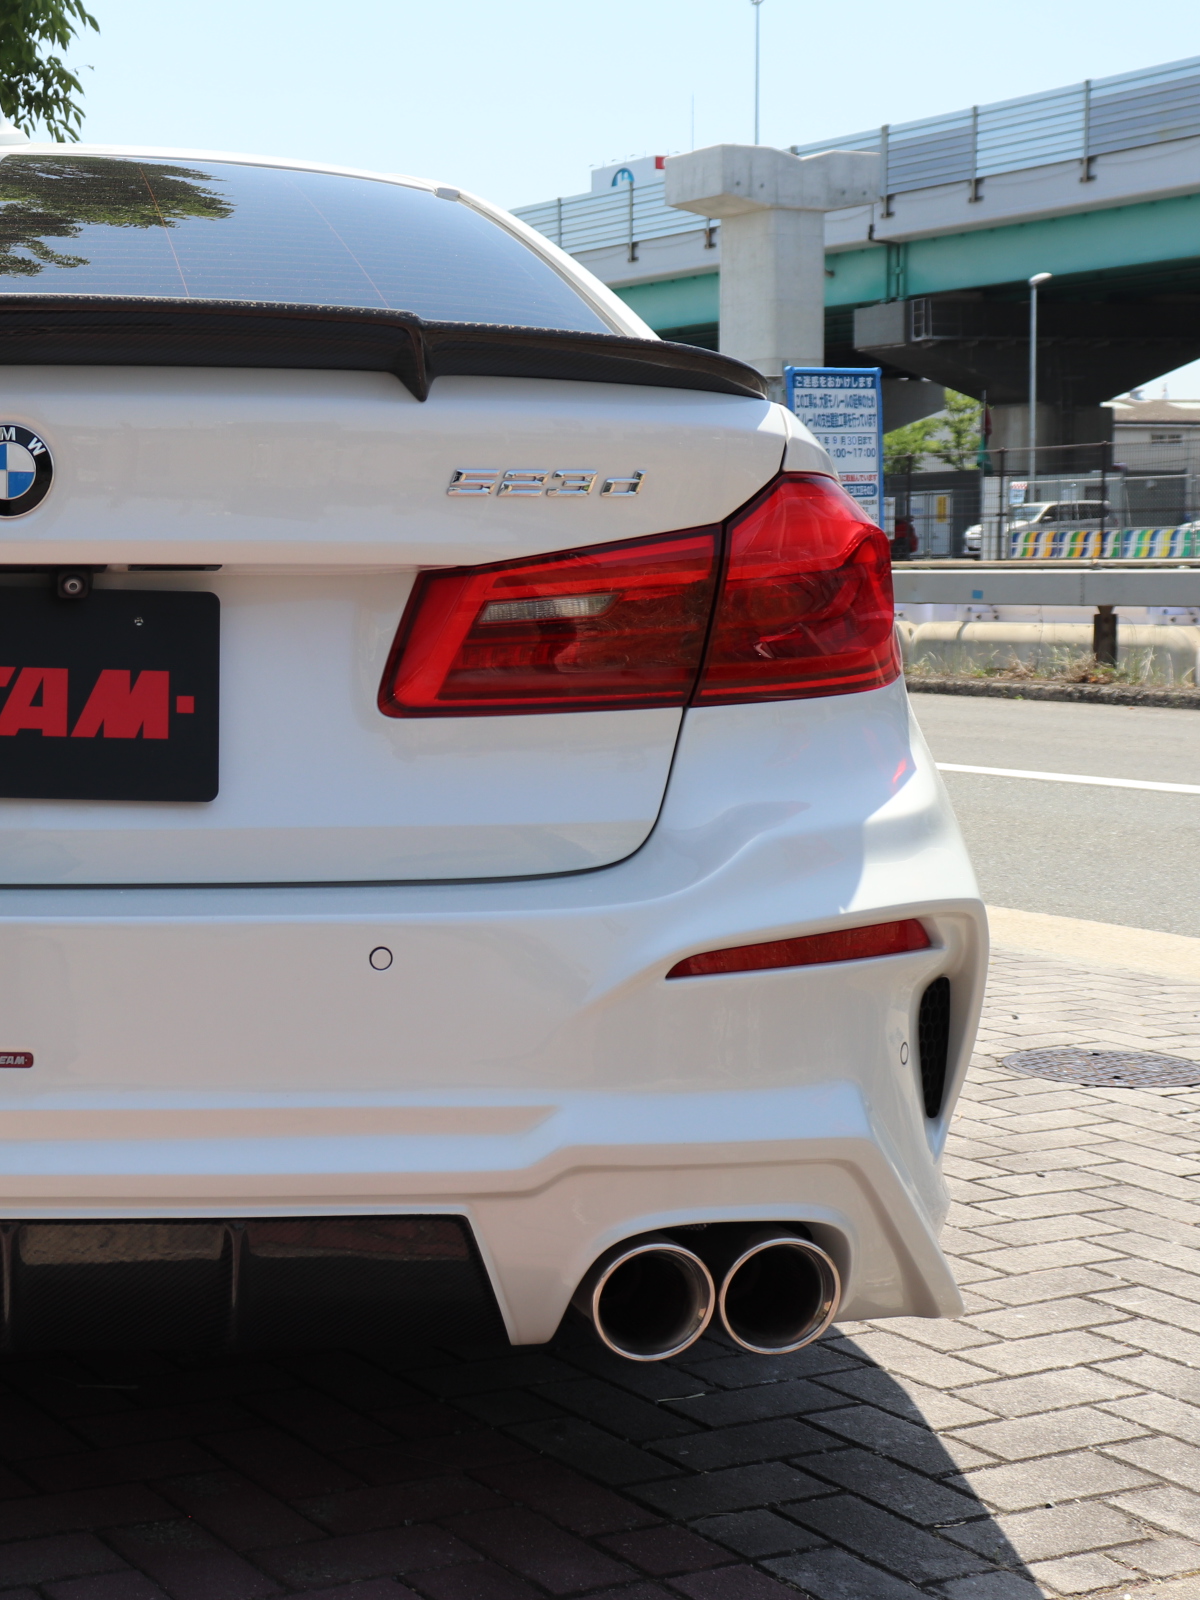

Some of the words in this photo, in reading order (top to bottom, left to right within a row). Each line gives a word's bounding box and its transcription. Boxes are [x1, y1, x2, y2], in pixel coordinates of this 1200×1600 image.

[795, 376, 874, 388] ご迷惑をおかけします
[447, 469, 648, 497] 523d
